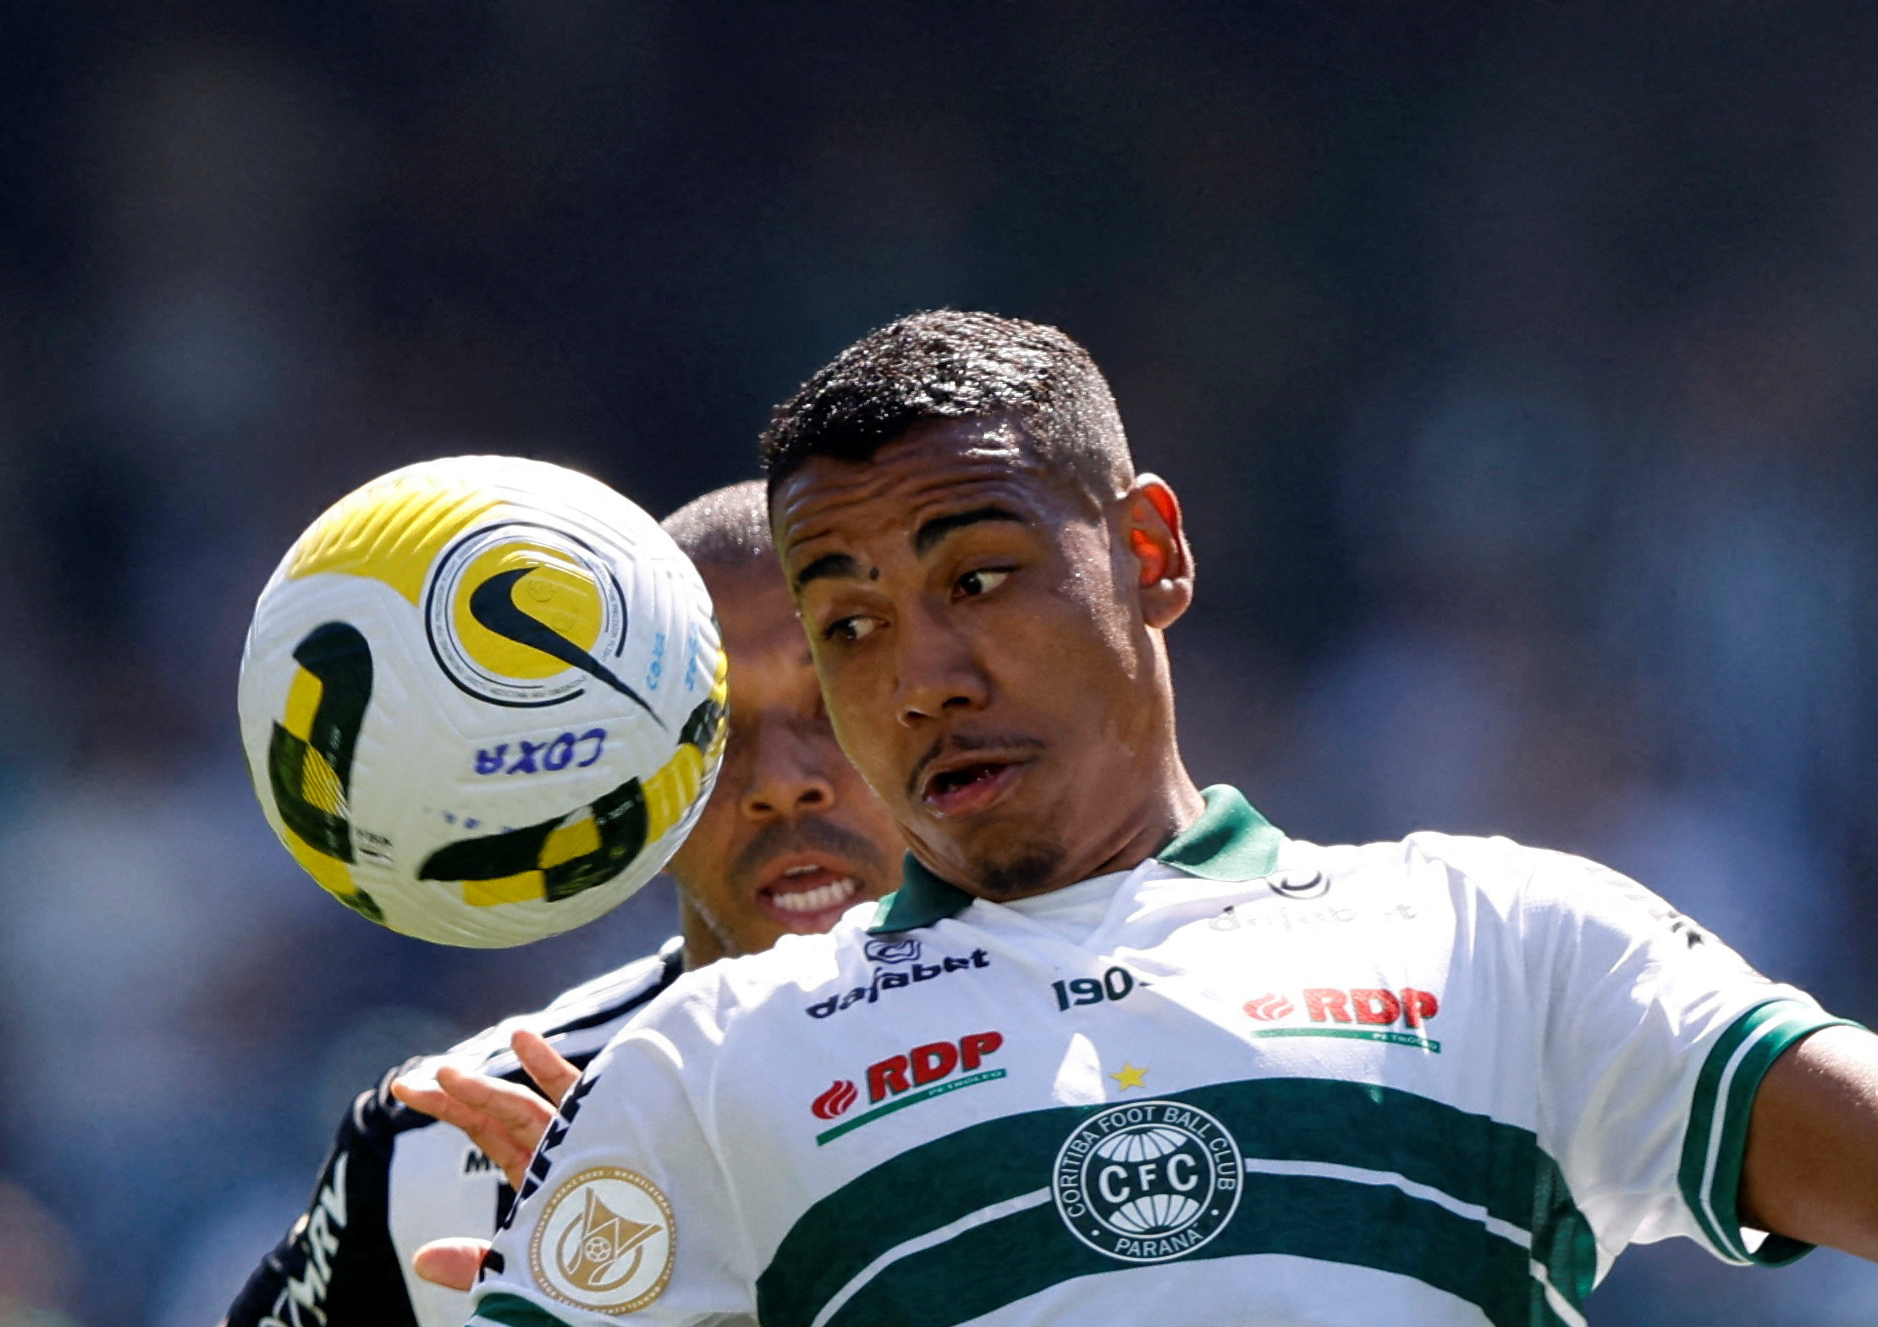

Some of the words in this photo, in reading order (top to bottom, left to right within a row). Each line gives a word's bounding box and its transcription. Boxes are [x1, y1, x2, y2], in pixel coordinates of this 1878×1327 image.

[1303, 986, 1439, 1029] RDP
[865, 1030, 1003, 1105] RDP
[1059, 1130, 1101, 1218] CORITIBA
[1098, 1106, 1156, 1133] FOOT
[1162, 1107, 1212, 1139] BALL
[1209, 1136, 1237, 1191] CLUB
